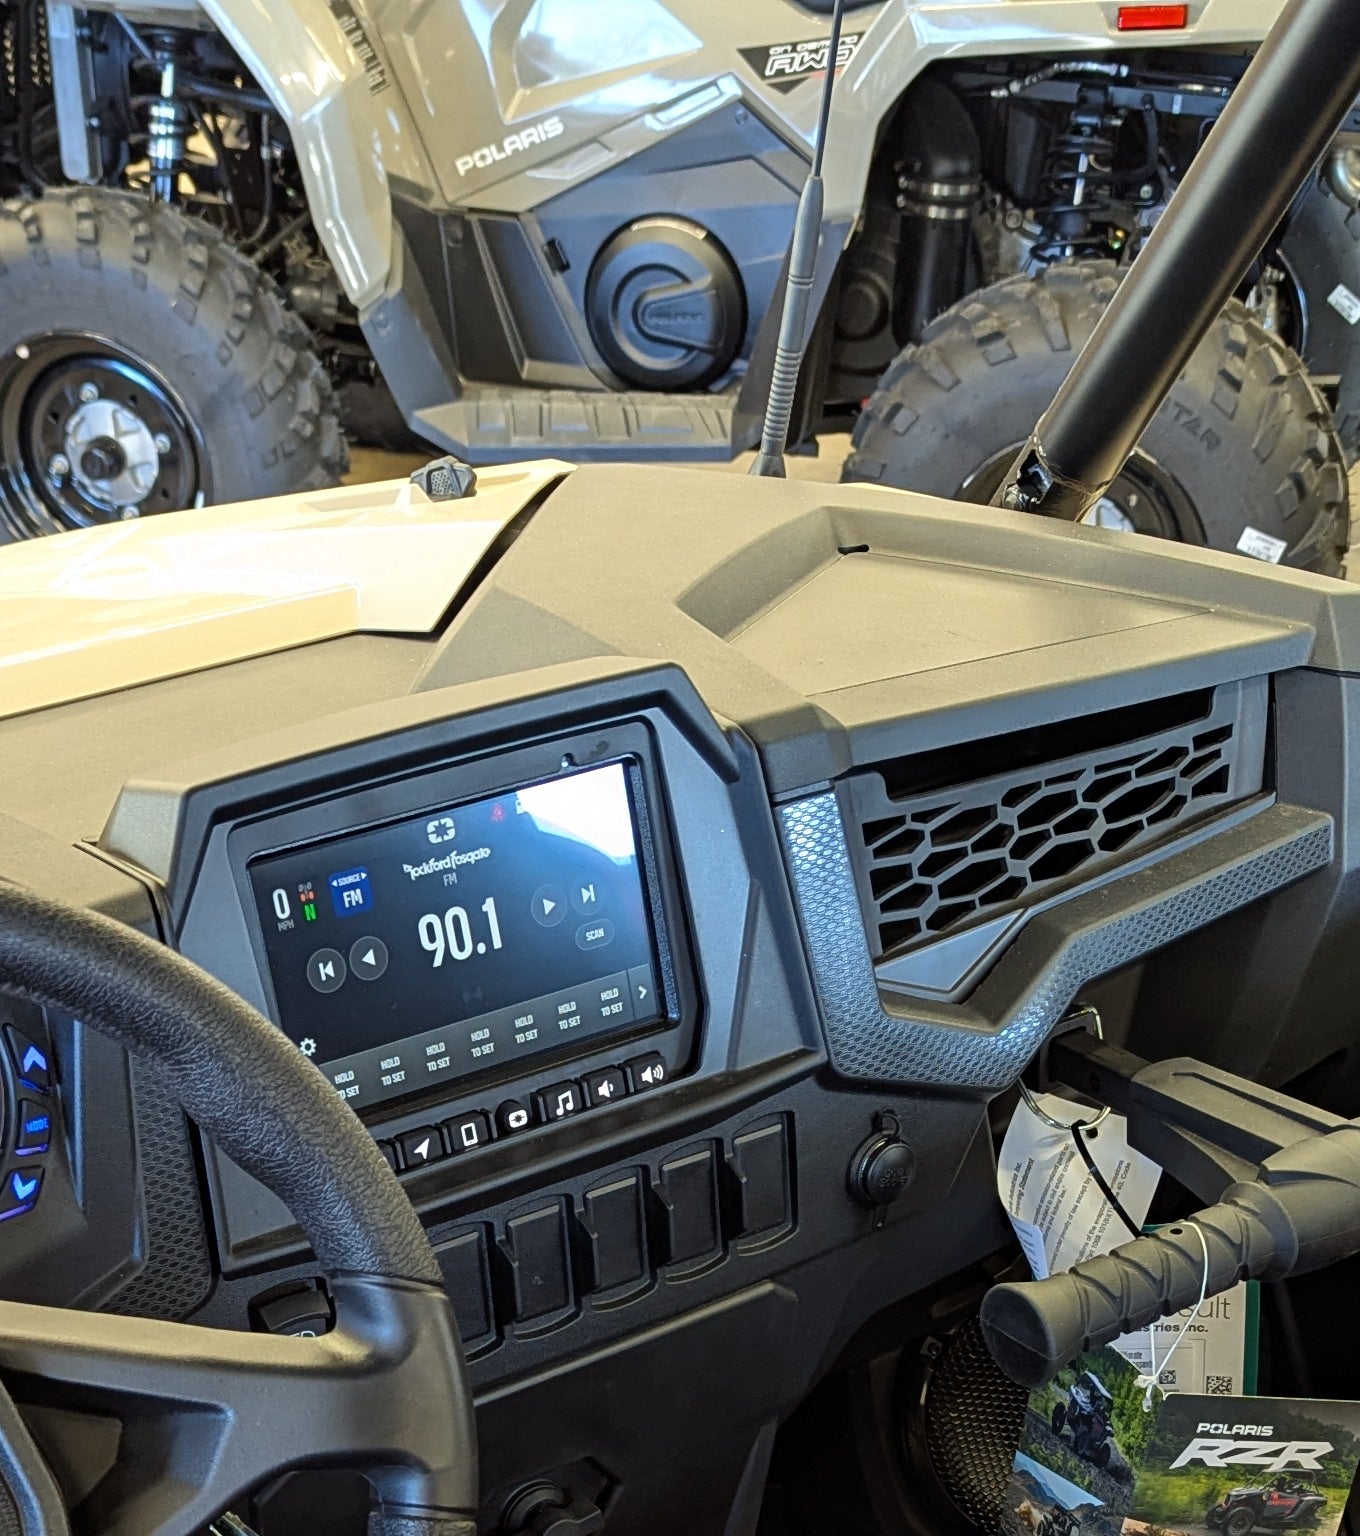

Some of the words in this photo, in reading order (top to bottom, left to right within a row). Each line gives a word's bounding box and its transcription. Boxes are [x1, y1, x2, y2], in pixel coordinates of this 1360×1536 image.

[455, 116, 564, 177] POLARIS
[338, 873, 361, 887] SOURCE
[443, 872, 458, 886] FM
[273, 888, 291, 920] 0
[343, 888, 364, 908] FM
[304, 903, 317, 921] N
[277, 919, 295, 932] MPH
[418, 896, 503, 968] 90.1
[585, 928, 605, 941] SCAN
[600, 988, 619, 1001] HOLD
[558, 1002, 577, 1014] HOLD
[601, 1006, 611, 1016] TO
[611, 1002, 623, 1014] SET
[515, 1015, 534, 1028] HOLD
[558, 1020, 568, 1030] TO
[569, 1015, 581, 1028] SET
[471, 1028, 490, 1042] HOLD
[515, 1034, 525, 1044] TO
[526, 1029, 538, 1041] SET
[426, 1042, 446, 1056] HOLD
[471, 1047, 481, 1058] TO
[482, 1043, 494, 1056] SET
[381, 1056, 401, 1070] HOLD
[427, 1061, 437, 1072] TO
[438, 1056, 451, 1069] SET
[334, 1070, 355, 1084] HOLD
[381, 1075, 392, 1086] TO
[393, 1071, 406, 1084] SET
[346, 1085, 360, 1098] SET
[26, 1117, 50, 1133] MODE
[1019, 1157, 1035, 1190] Statement
[1120, 1161, 1132, 1179] Code
[1059, 1220, 1072, 1239] penalty
[1075, 1184, 1088, 1204] except
[1196, 1423, 1274, 1437] POLARIS
[1169, 1438, 1334, 1471] RZR
